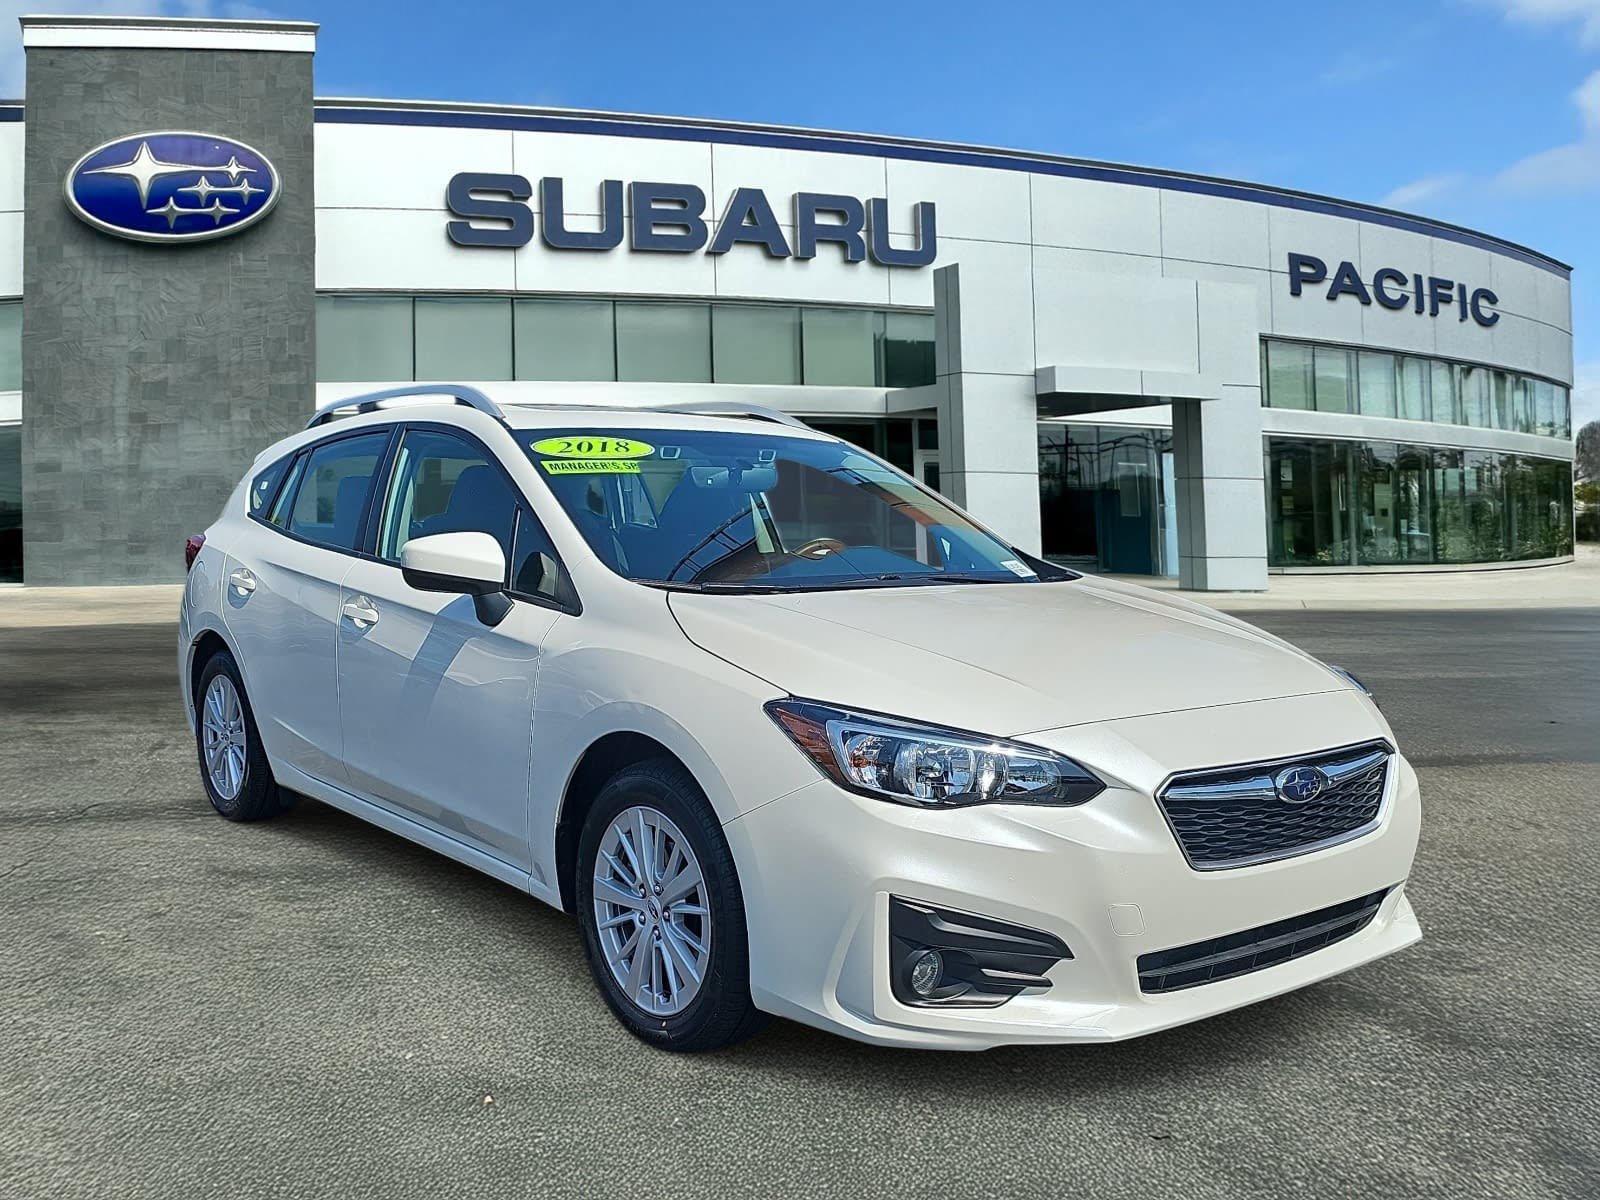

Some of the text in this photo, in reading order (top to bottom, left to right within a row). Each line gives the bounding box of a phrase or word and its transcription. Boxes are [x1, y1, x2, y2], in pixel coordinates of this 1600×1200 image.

[446, 172, 937, 268] SUBARU
[1288, 252, 1500, 327] PACIFIC
[548, 461, 620, 471] MANAGER'S
[558, 441, 630, 453] 2018
